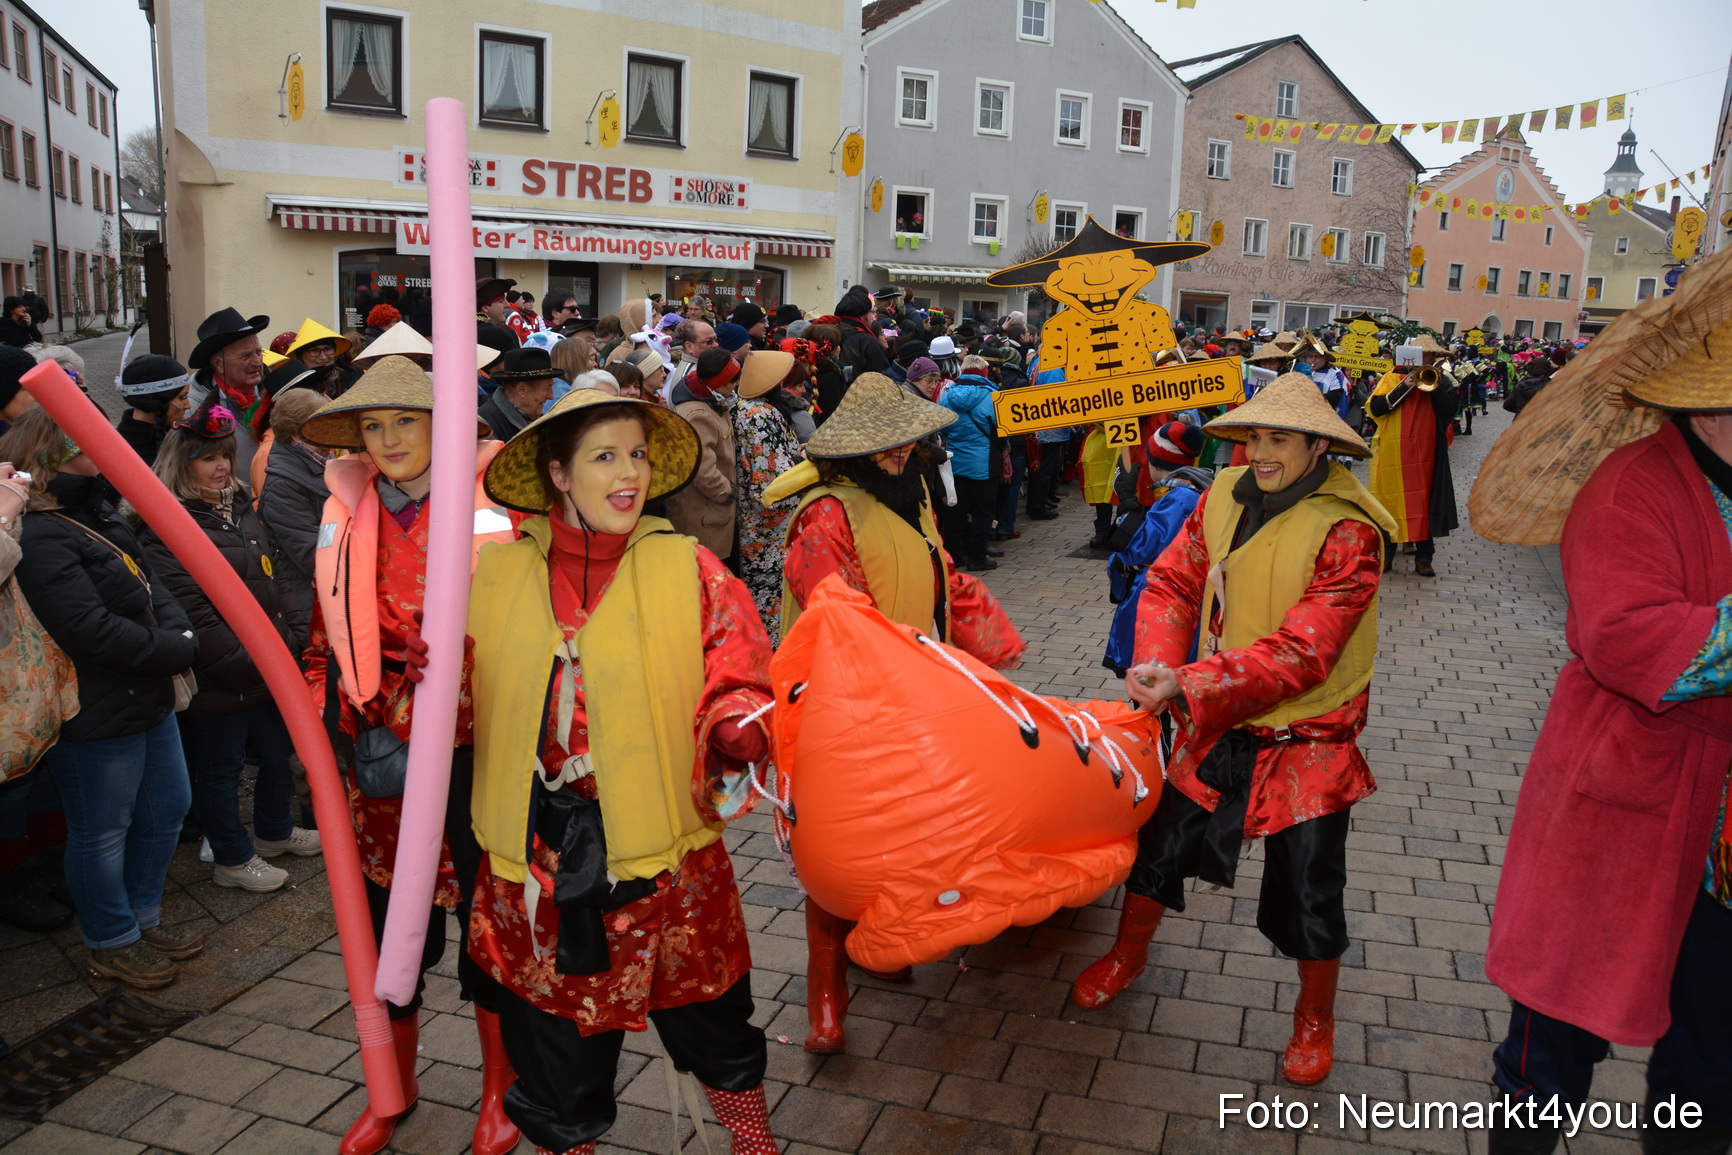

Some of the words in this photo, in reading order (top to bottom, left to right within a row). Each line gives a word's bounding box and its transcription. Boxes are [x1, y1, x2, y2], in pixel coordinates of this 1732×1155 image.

[522, 159, 653, 203] STREB
[696, 191, 734, 205] MORE
[403, 222, 526, 249] Wter-
[533, 229, 751, 261] Räumungsverkauf
[715, 286, 736, 295] STREB
[1359, 359, 1387, 369] Gmixde
[1010, 387, 1124, 424] Stadtkapelle
[1132, 374, 1225, 404] Beilngries
[1108, 422, 1138, 445] 25
